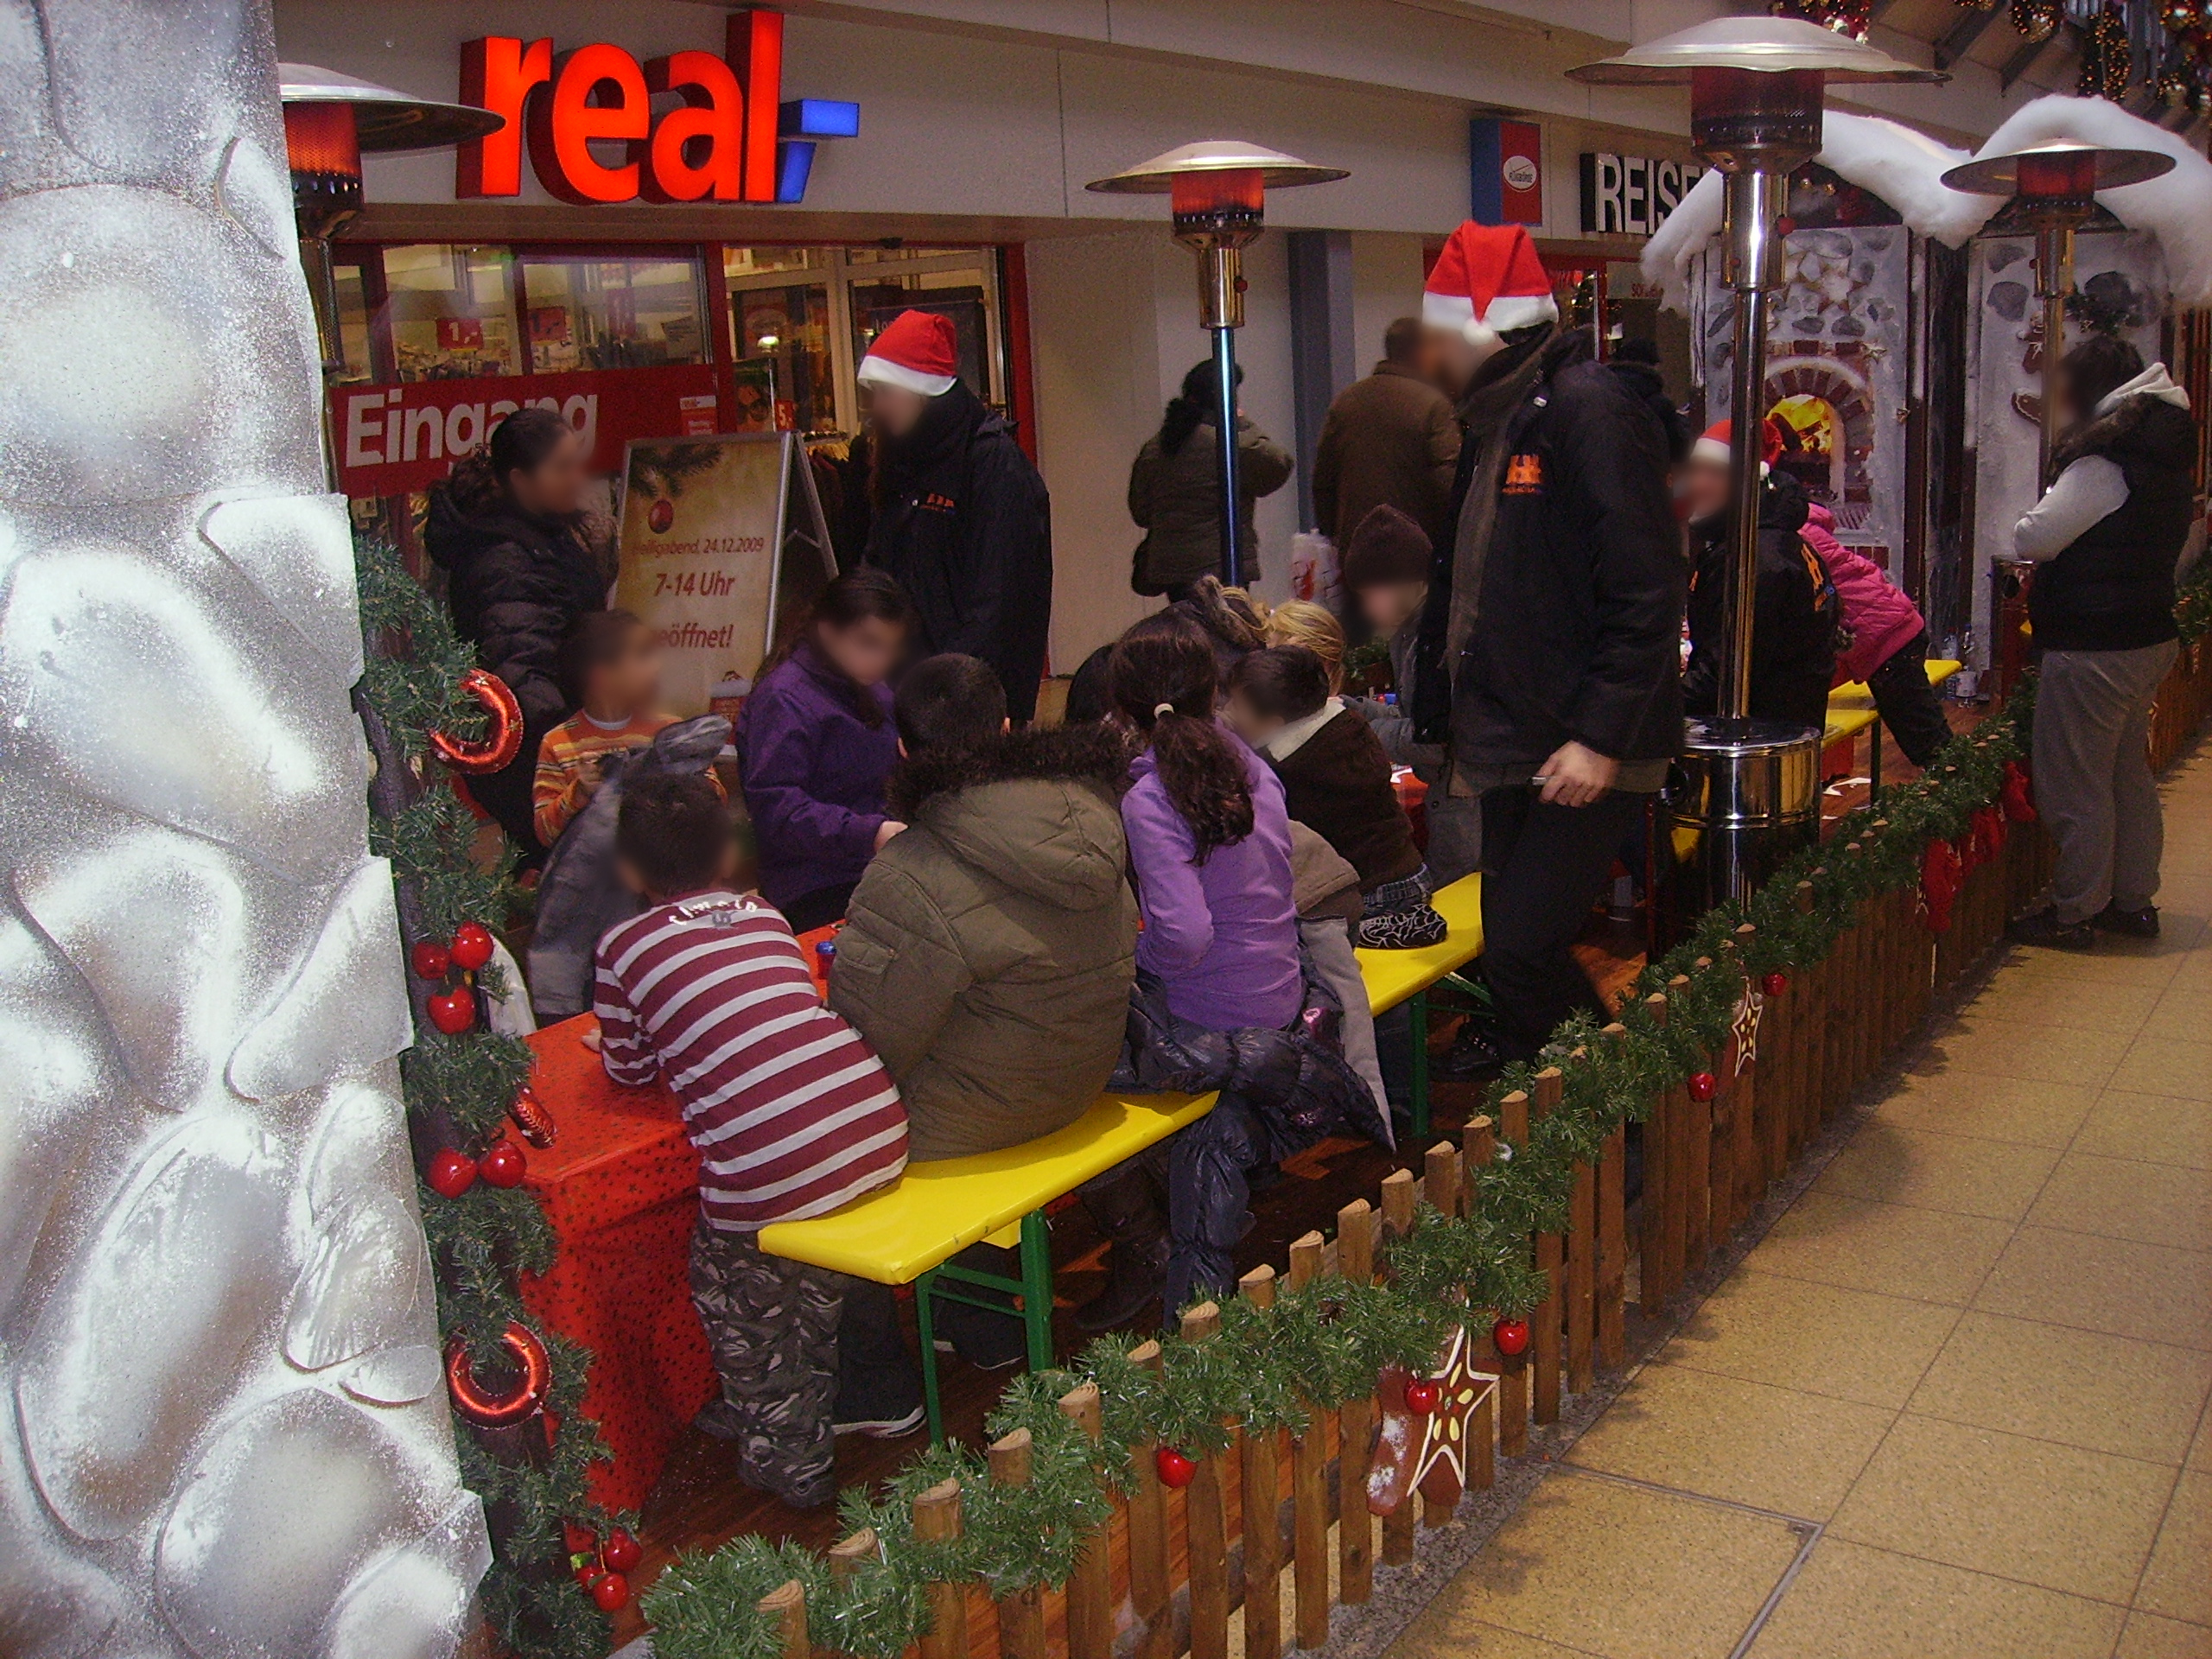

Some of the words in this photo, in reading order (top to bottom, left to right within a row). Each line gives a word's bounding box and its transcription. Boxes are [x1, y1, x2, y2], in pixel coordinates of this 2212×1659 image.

[1596, 152, 1713, 235] REIS
[702, 537, 764, 555] 24.12.2009
[654, 572, 696, 597] 7-14
[700, 570, 735, 596] Uhr
[651, 622, 734, 649] eöffnet!
